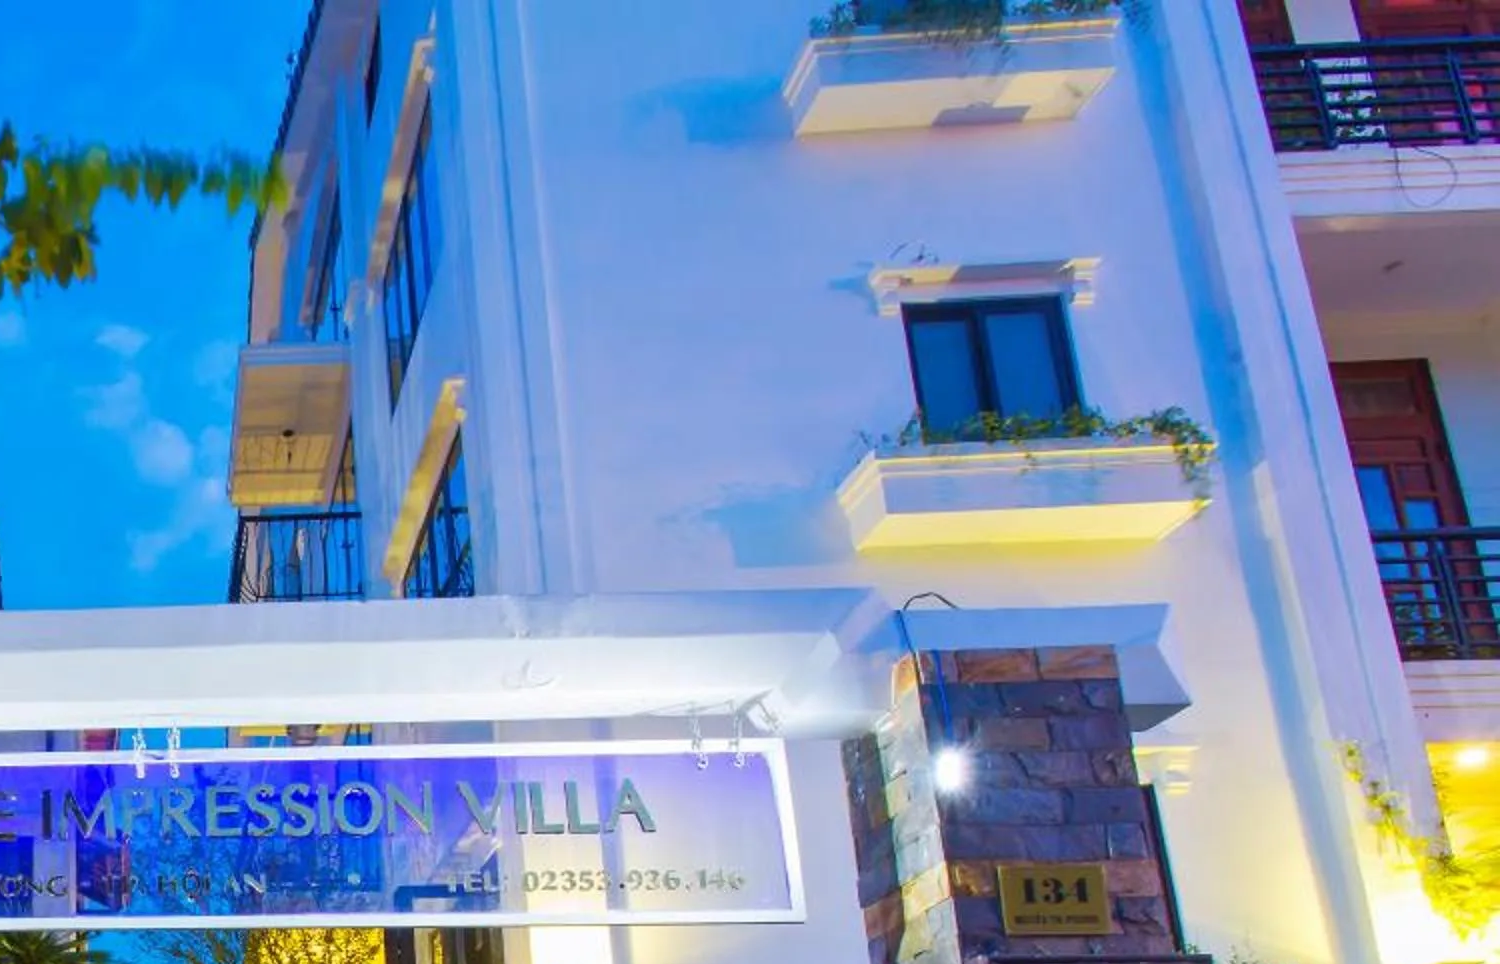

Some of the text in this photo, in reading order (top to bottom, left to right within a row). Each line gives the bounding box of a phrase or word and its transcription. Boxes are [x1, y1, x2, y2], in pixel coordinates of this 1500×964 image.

[42, 780, 433, 841] IMPRESSION
[457, 779, 657, 836] VILLA
[1021, 878, 1090, 904] 134
